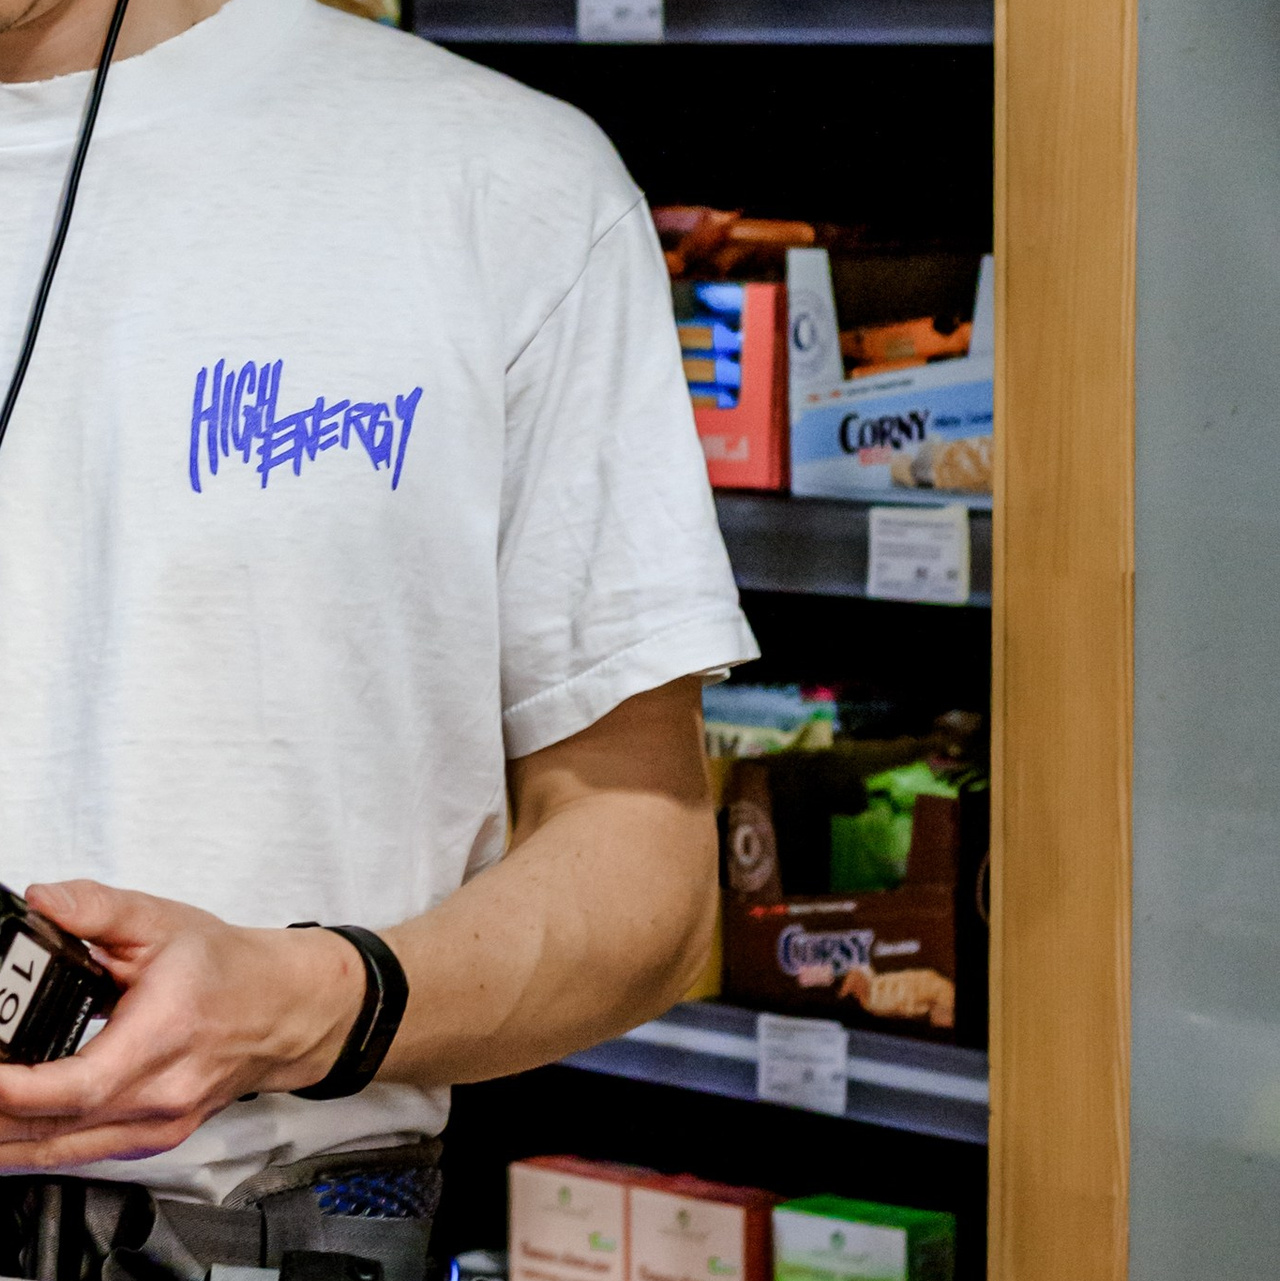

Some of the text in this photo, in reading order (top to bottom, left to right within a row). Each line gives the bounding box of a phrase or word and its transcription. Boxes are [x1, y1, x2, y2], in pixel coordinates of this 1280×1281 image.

[190, 358, 424, 494] HIGH ENERGY
[838, 408, 932, 455] CORNY
